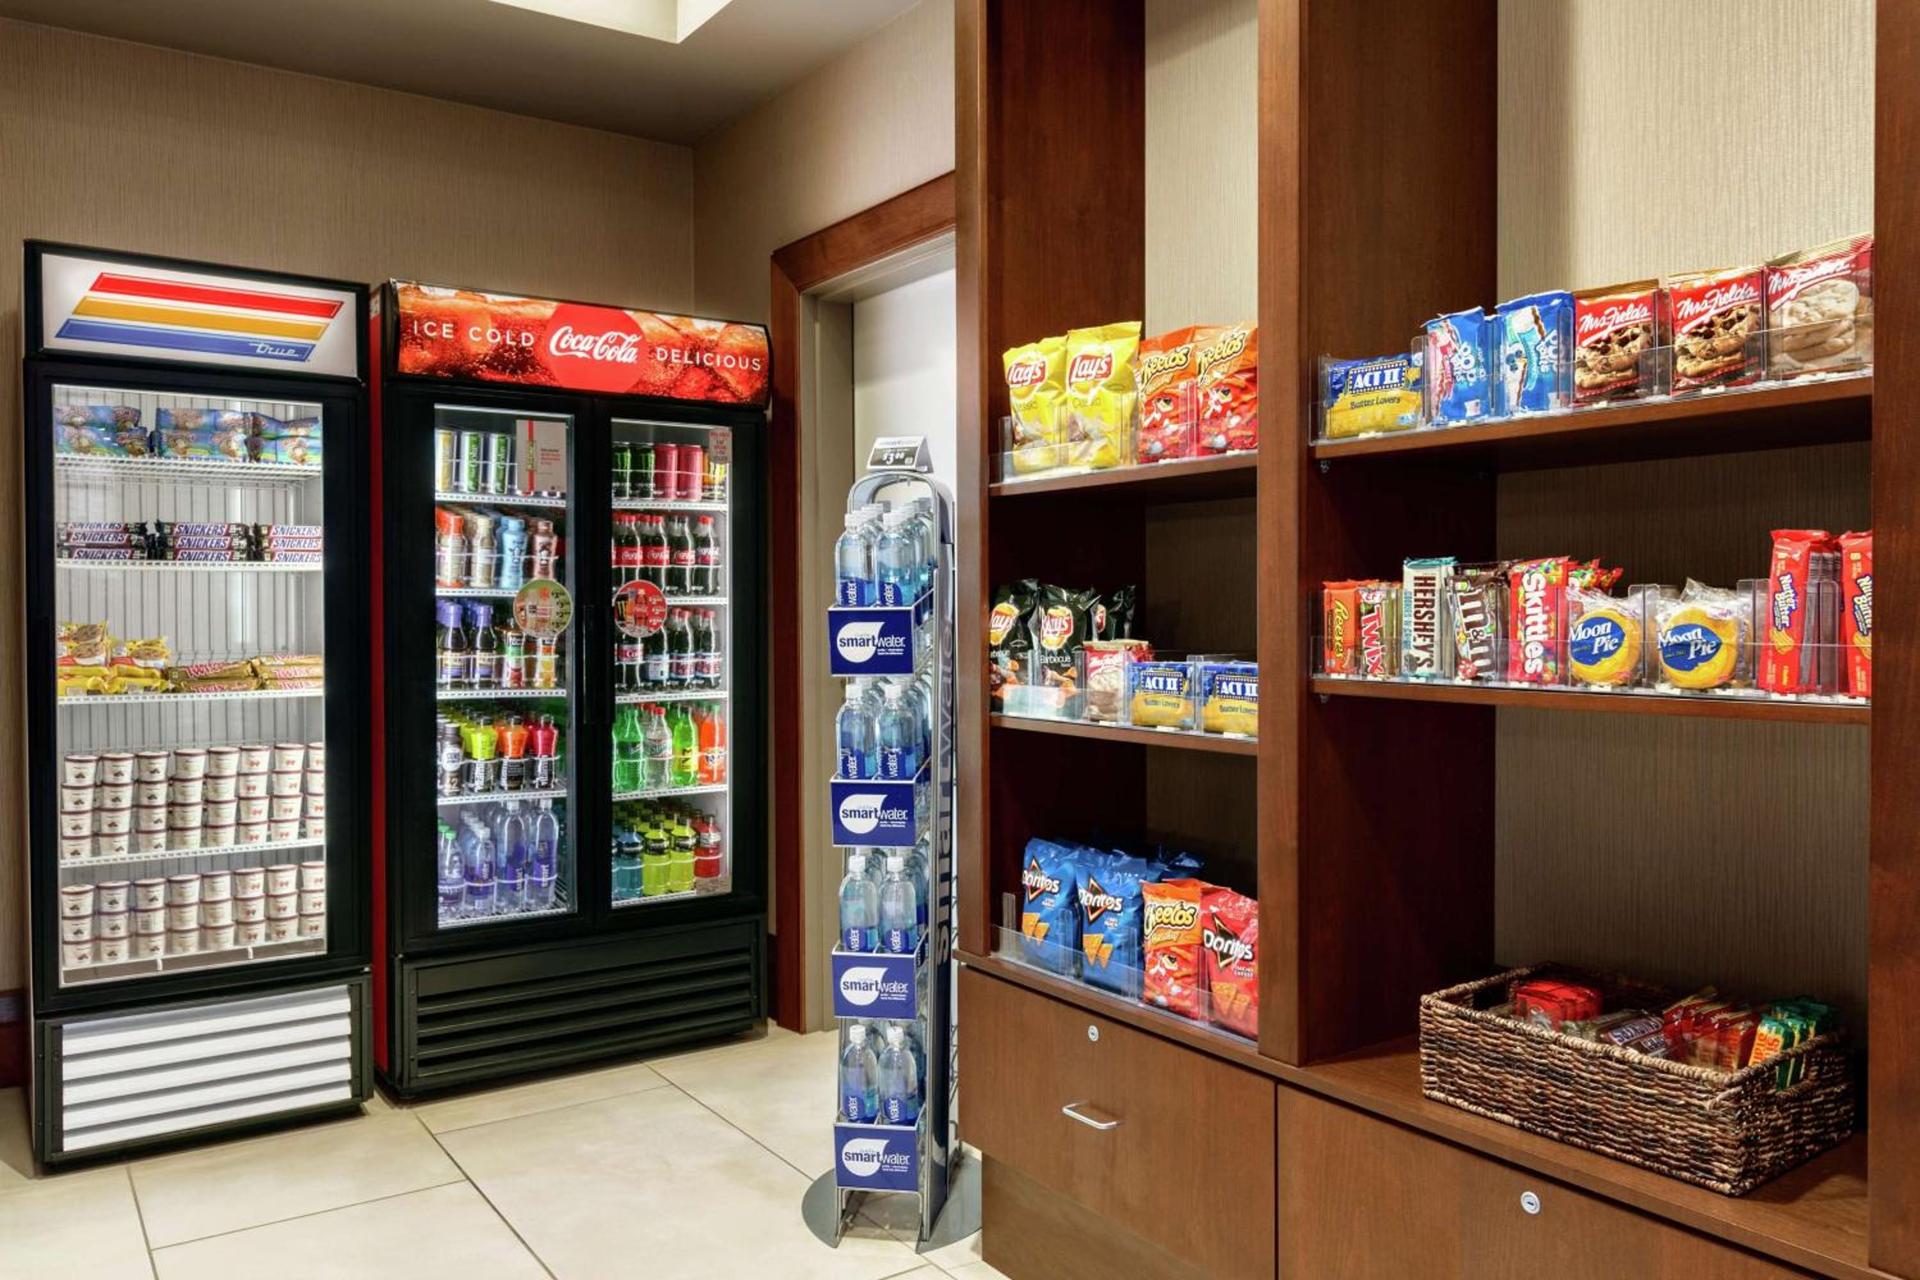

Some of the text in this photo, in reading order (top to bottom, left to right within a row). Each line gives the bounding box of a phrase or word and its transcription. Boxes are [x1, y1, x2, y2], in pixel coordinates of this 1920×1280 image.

[1705, 283, 1758, 315] Fields
[413, 319, 535, 347] ICE COLD
[248, 342, 302, 358] True
[549, 325, 643, 363] Coca-Cola
[655, 346, 762, 371] DELICIOUS
[1353, 367, 1402, 390] ACT II
[176, 524, 225, 535] SNICKERS
[178, 537, 229, 548] SNICKERS
[78, 550, 129, 559] SNICKERS
[179, 551, 230, 561] SNICKERS
[1413, 576, 1436, 668] HERSHEY'S
[1522, 573, 1547, 674] Skittles
[1570, 621, 1612, 642] Moon
[1592, 635, 1619, 655] Pie
[1657, 628, 1704, 649] Moon
[1687, 640, 1717, 660] Pie
[1145, 676, 1178, 691] ACT II
[1220, 681, 1243, 695] ACT
[1203, 928, 1253, 960] Doritos
